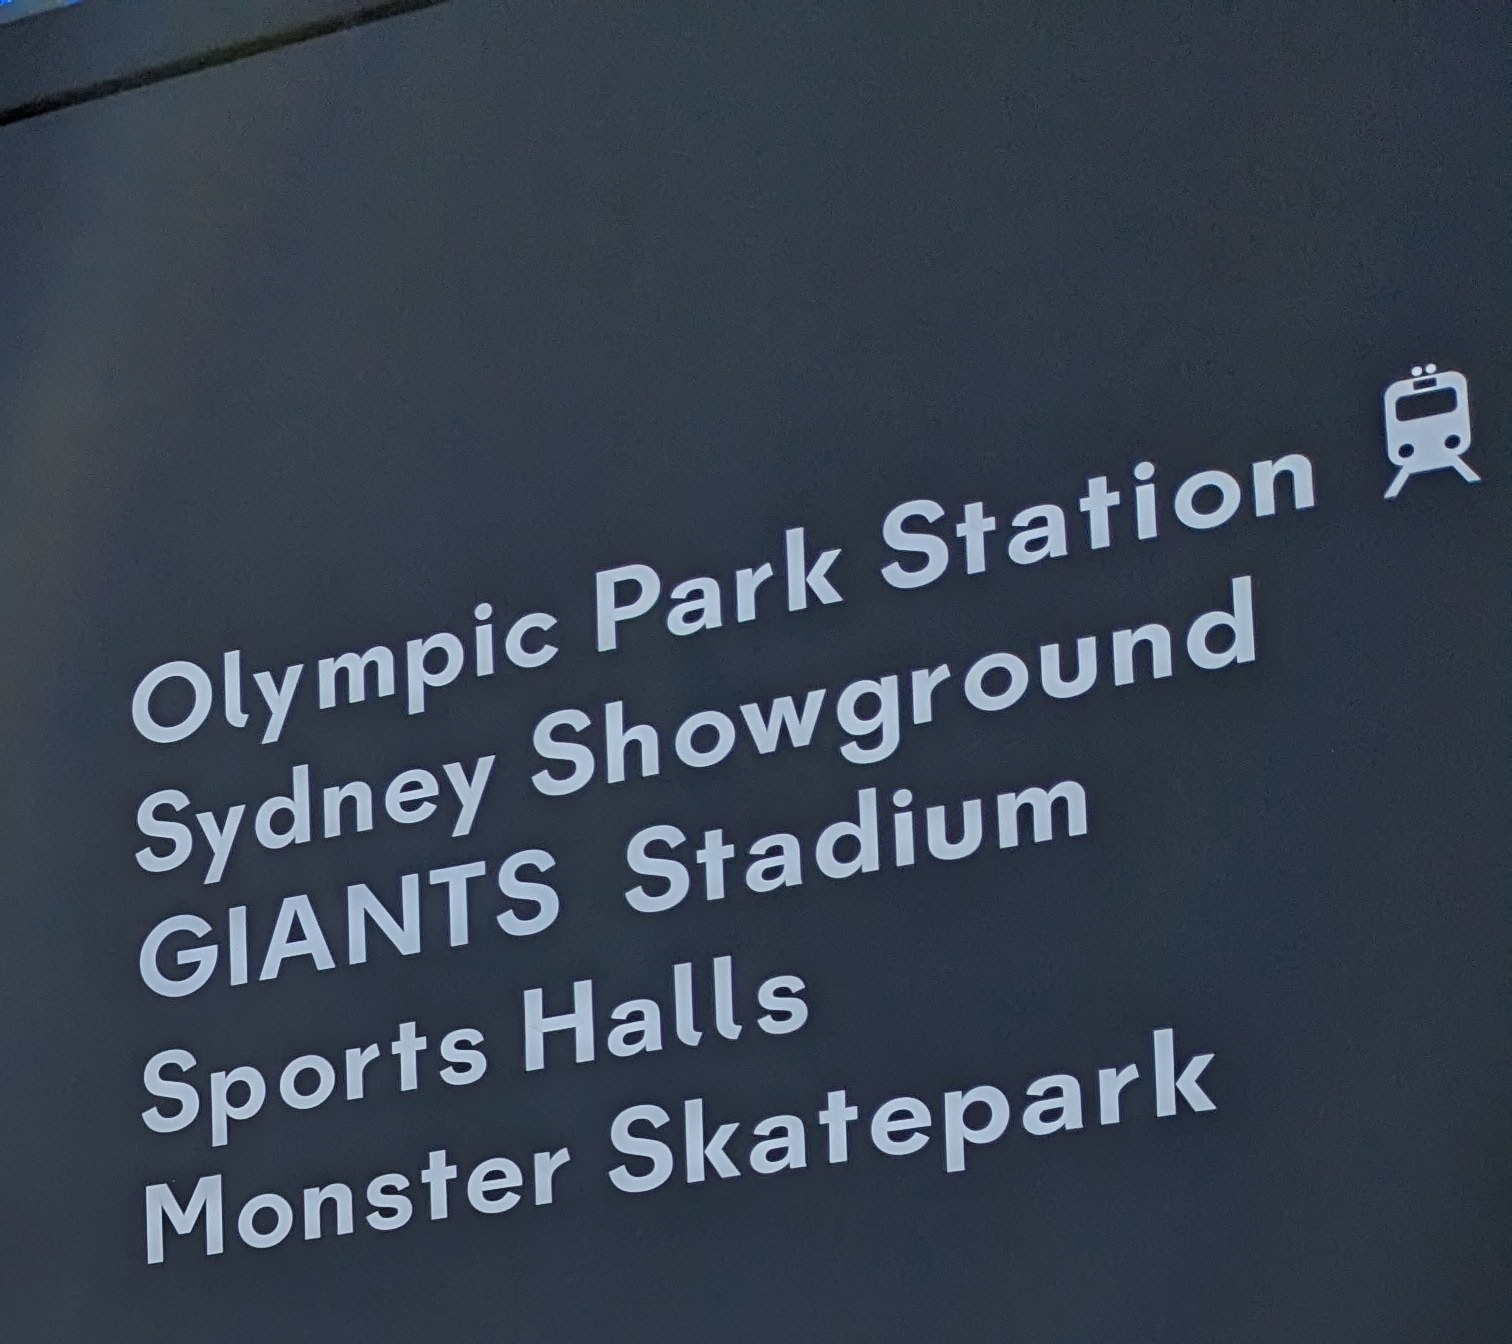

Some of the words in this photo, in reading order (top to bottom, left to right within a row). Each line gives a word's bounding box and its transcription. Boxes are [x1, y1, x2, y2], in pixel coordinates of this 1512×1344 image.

[132, 603, 558, 744] Olympic
[596, 527, 843, 652] Park
[881, 454, 1314, 588] Station
[135, 755, 495, 884] Sydney
[532, 574, 1257, 797] Showground
[140, 848, 561, 998] GIANTS
[625, 781, 1087, 912] Stadium
[142, 1022, 486, 1147] Sports
[524, 956, 808, 1071] Halls
[146, 1148, 570, 1264] Monster
[609, 1028, 1216, 1192] Skatepark
